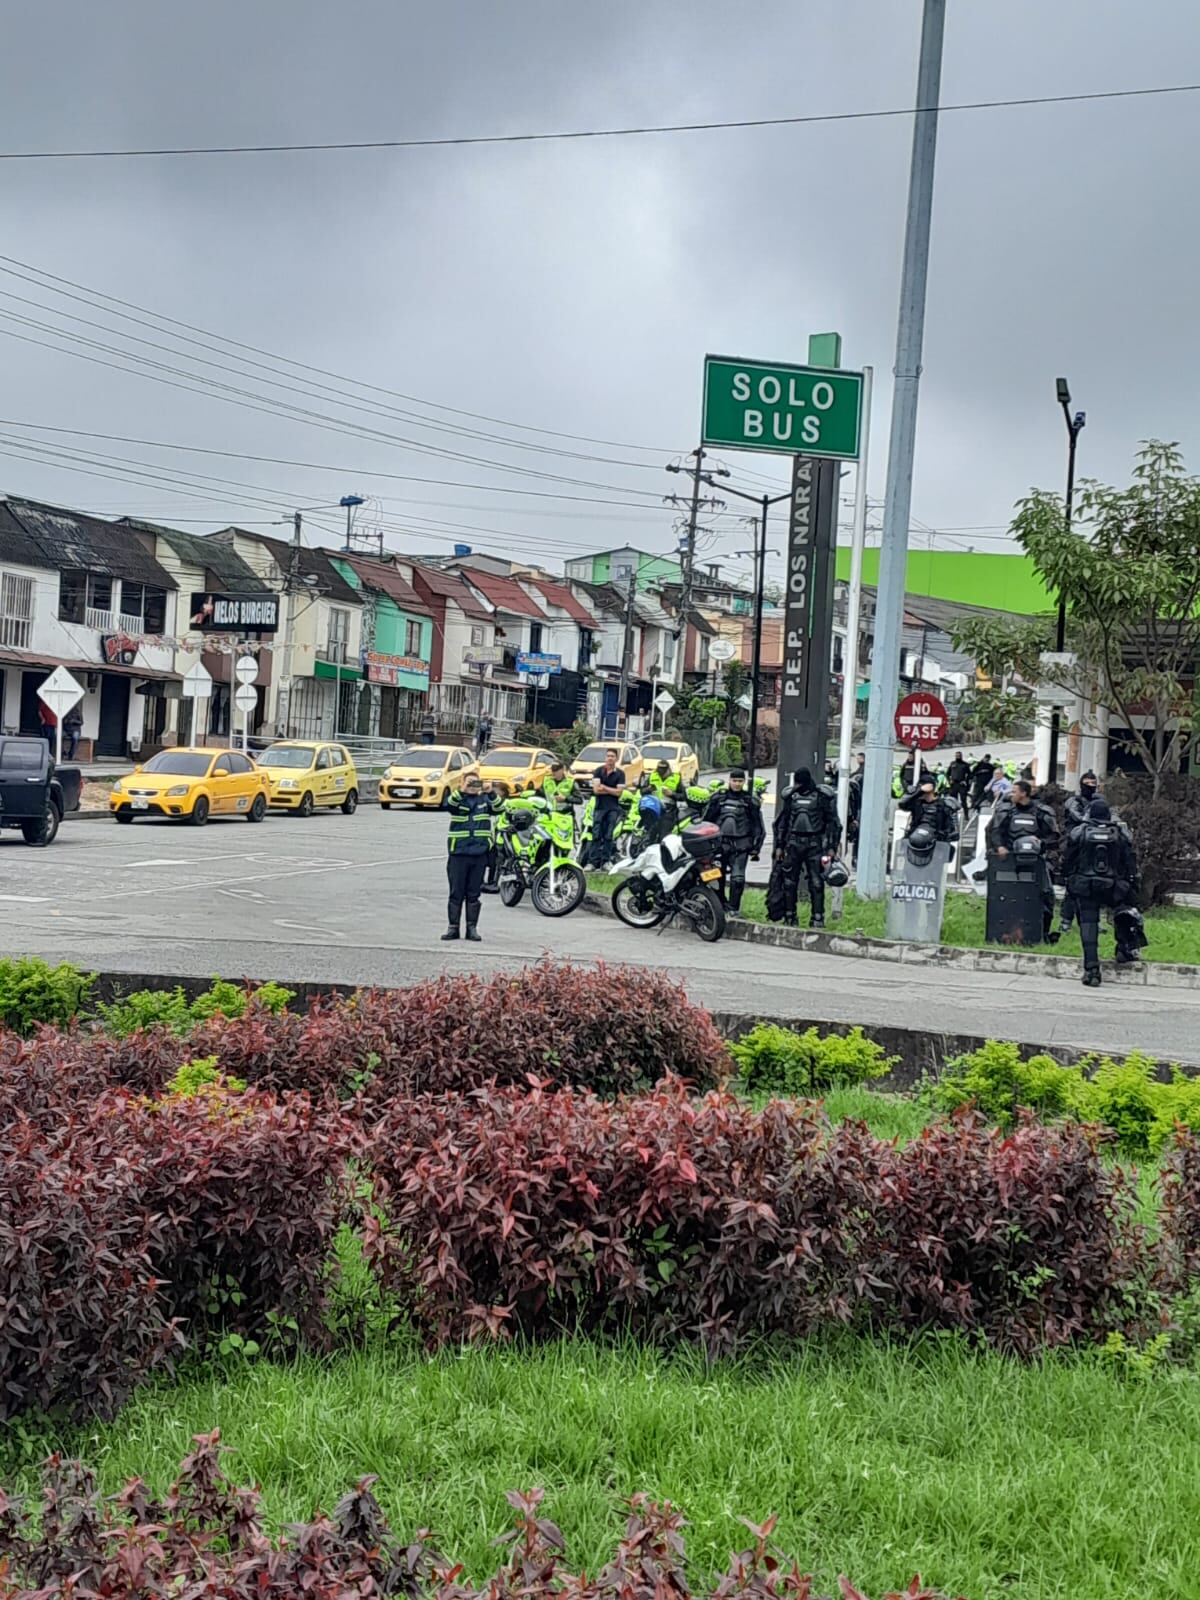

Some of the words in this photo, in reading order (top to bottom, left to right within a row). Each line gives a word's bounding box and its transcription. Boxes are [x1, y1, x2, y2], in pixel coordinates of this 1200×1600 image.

[731, 372, 834, 411] SOLO
[743, 409, 821, 444] BUS
[793, 456, 813, 545] NARA
[789, 554, 807, 609] LOS
[240, 600, 277, 625] BURGUER
[911, 702, 931, 716] NO
[901, 725, 940, 740] PASE
[892, 885, 937, 900] POLICIA
